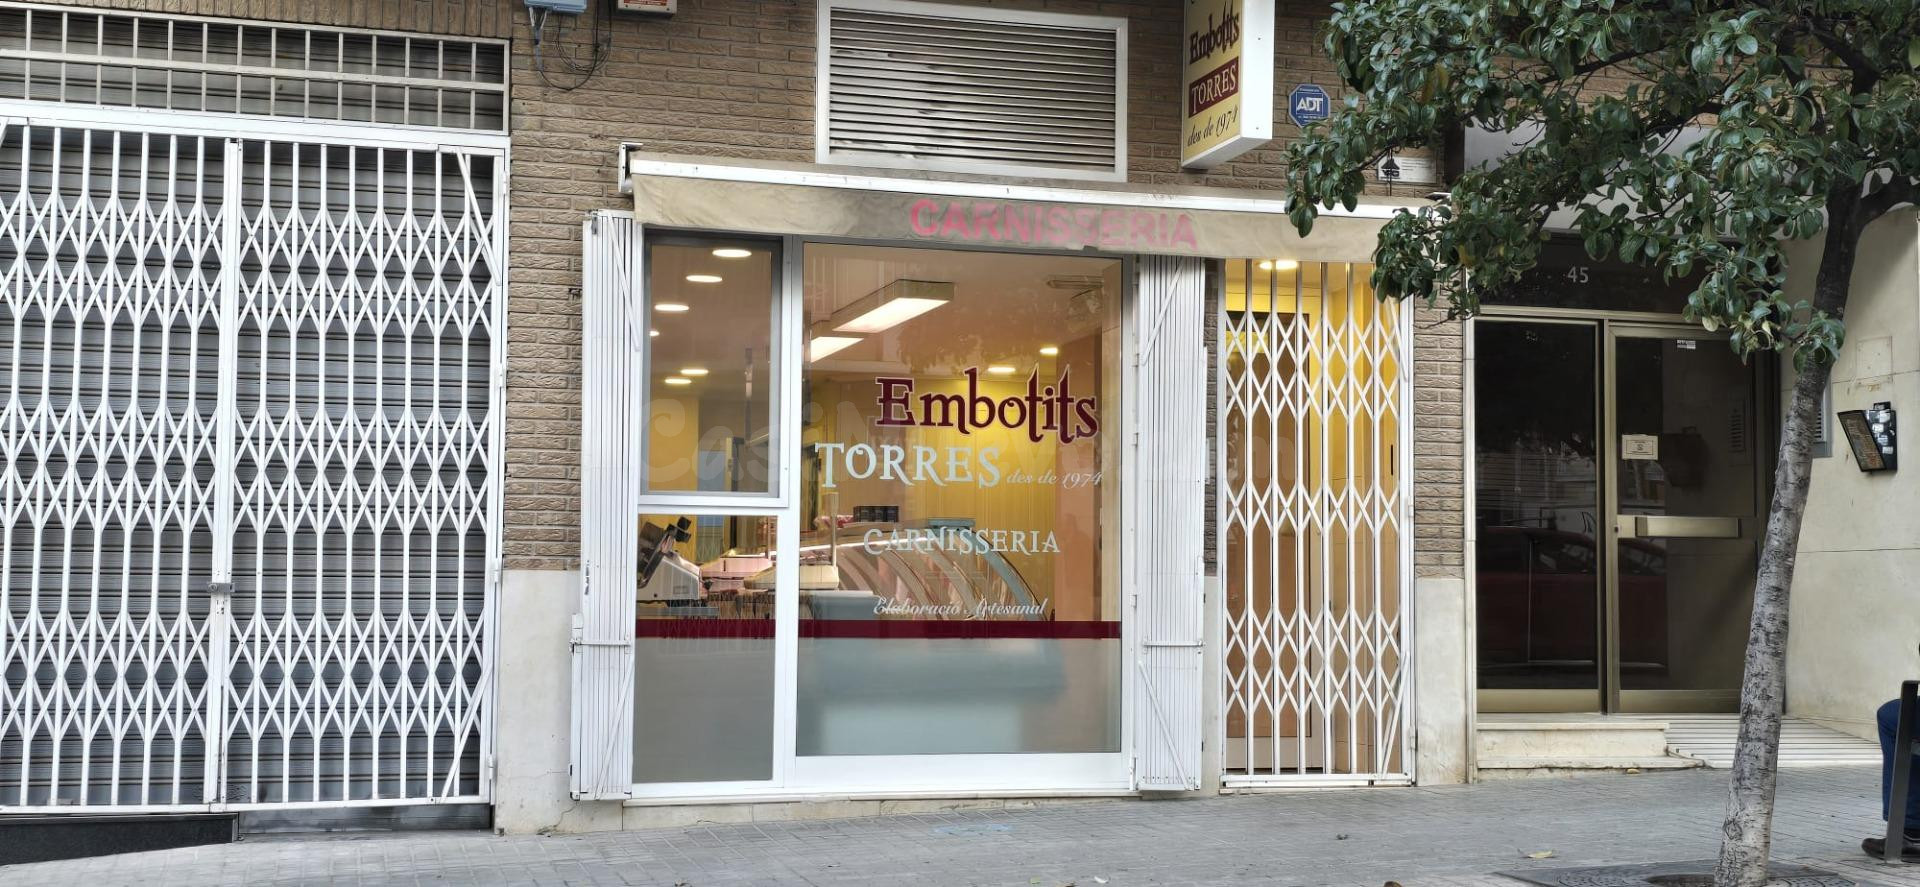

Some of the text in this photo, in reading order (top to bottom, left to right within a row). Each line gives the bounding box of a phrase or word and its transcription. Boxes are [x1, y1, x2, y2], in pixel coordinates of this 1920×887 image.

[1190, 0, 1240, 65] Embotits
[1191, 63, 1237, 115] TORRES
[1296, 96, 1323, 112] ADT
[1187, 124, 1202, 147] des
[1203, 116, 1214, 139] de
[909, 199, 1199, 251] CARNISSERIA
[1567, 266, 1589, 283] 45
[875, 363, 1099, 444] Embotits
[814, 442, 1104, 490] TORRES des de 1974
[863, 526, 1061, 556] CARNISSERIA
[873, 596, 1048, 619] Elaboració Artesanal
